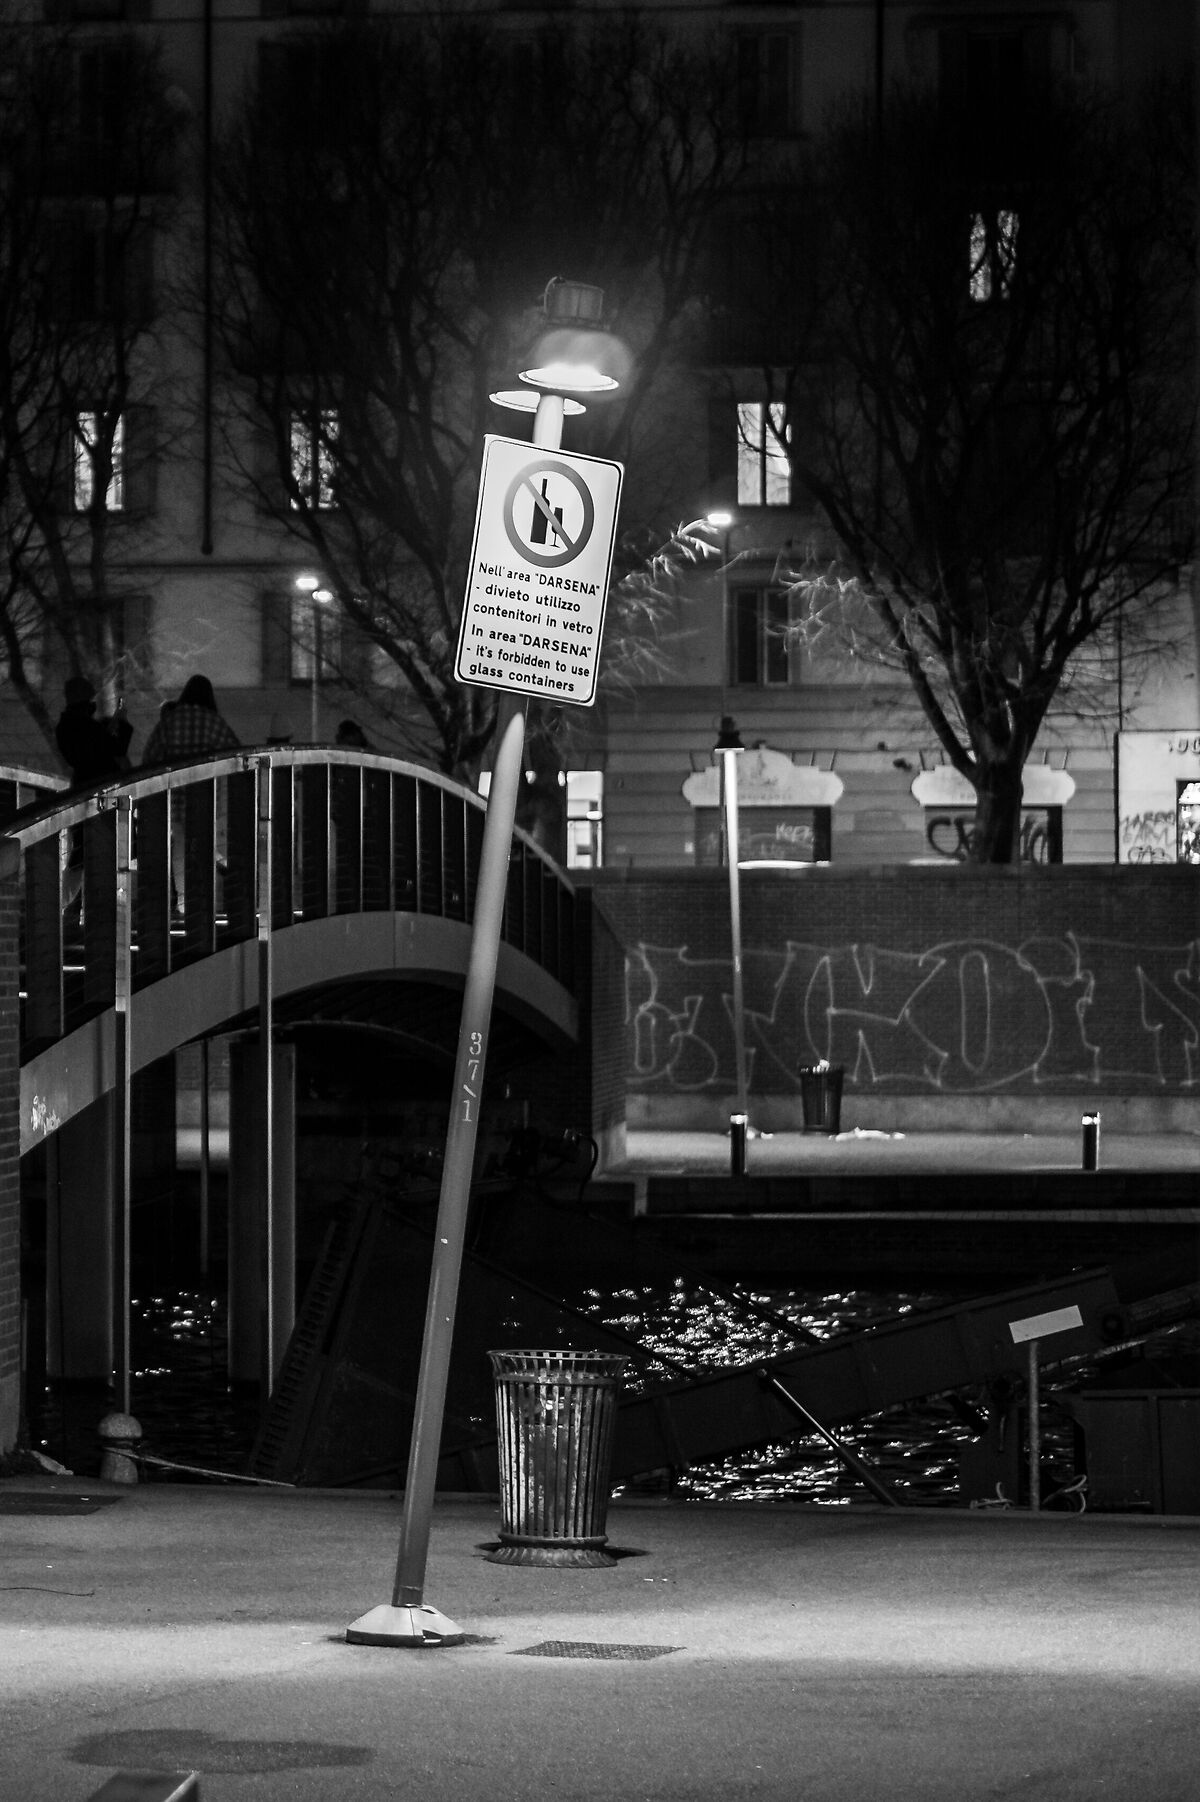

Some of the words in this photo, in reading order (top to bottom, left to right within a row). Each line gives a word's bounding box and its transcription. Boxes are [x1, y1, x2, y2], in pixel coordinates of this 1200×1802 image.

[485, 584, 530, 602] divieto
[536, 595, 581, 612] utilizzo
[471, 624, 483, 637] In
[489, 630, 516, 643] area
[473, 603, 541, 624] contenitori
[546, 615, 557, 627] in
[563, 621, 593, 635] vetro
[476, 645, 493, 658] it's
[498, 649, 550, 669] forbidden
[555, 660, 566, 672] to
[571, 665, 590, 677] use
[469, 663, 503, 677] glass
[508, 671, 574, 692] containers
